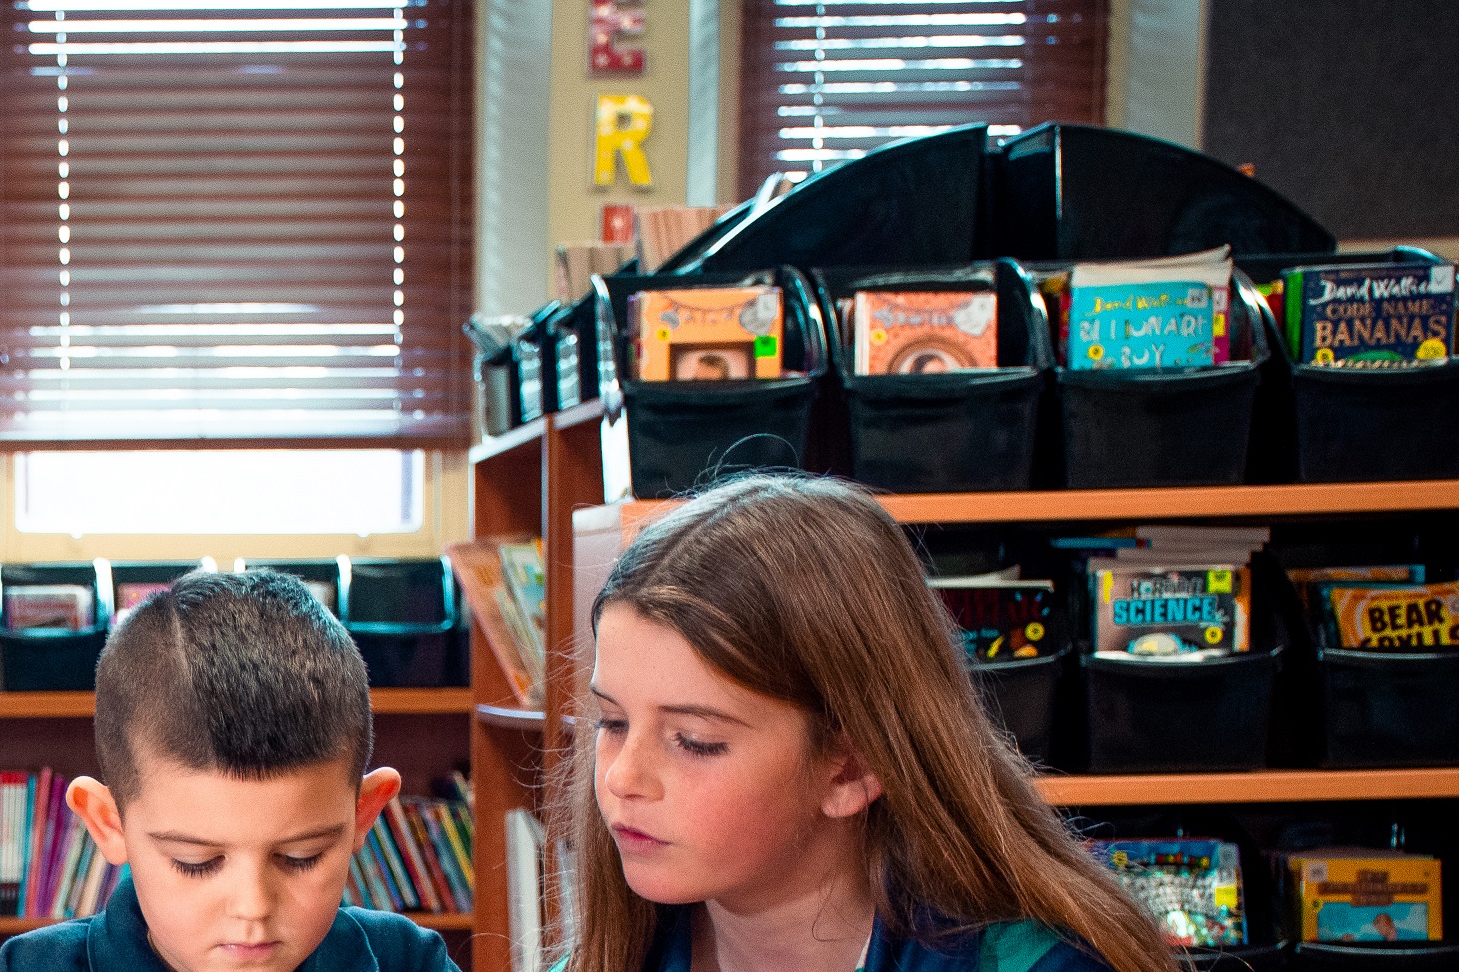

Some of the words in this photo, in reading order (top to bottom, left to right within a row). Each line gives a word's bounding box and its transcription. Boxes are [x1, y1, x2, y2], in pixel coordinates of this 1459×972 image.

[1315, 315, 1448, 347] BANANAS
[1113, 597, 1217, 626] SCIENCE
[1369, 599, 1445, 633] BEAR
